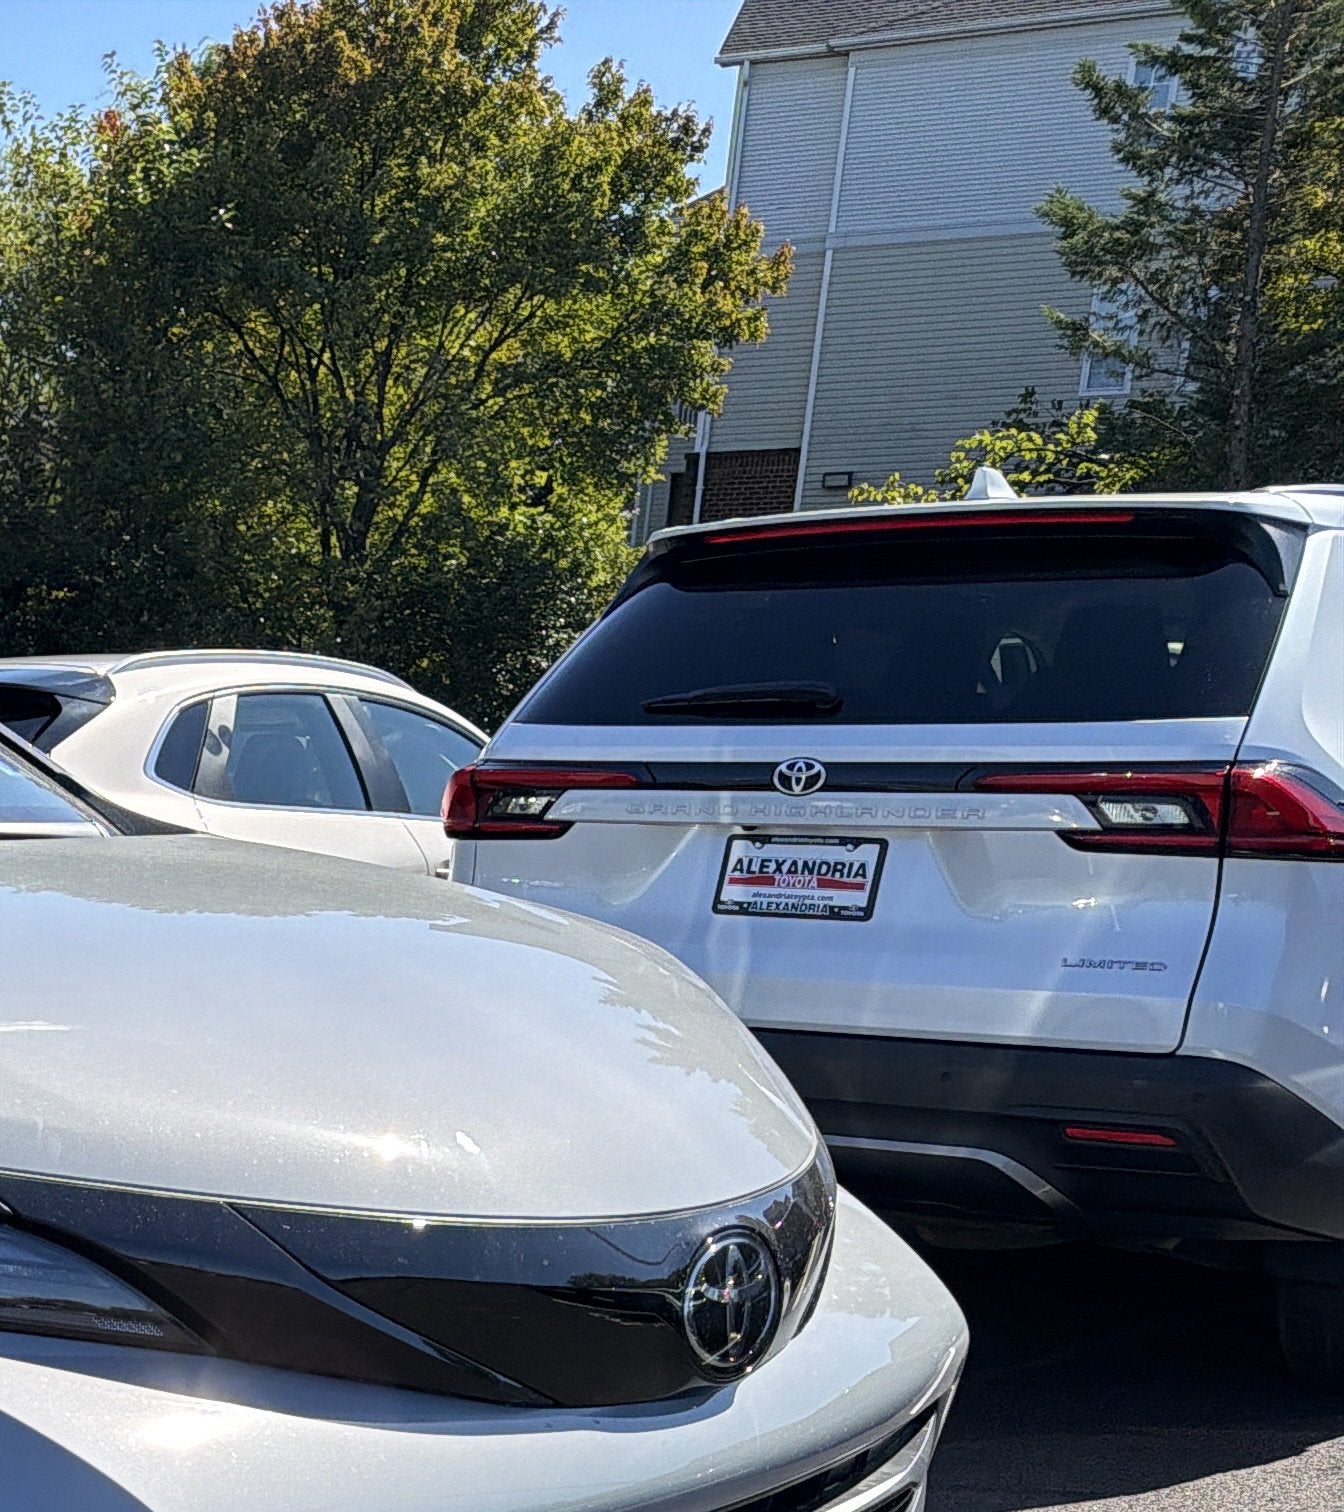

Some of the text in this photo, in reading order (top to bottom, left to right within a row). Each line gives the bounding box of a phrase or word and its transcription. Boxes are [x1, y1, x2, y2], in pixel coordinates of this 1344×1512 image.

[625, 803, 987, 821] GRAND HIGHLANDER
[730, 857, 868, 879] ALEXANDRIA
[774, 875, 818, 888] TOYOTA
[751, 891, 834, 903] alexandriatoyota.com
[748, 901, 830, 915] ALEXANDRIA
[1061, 958, 1168, 971] LIMITED
